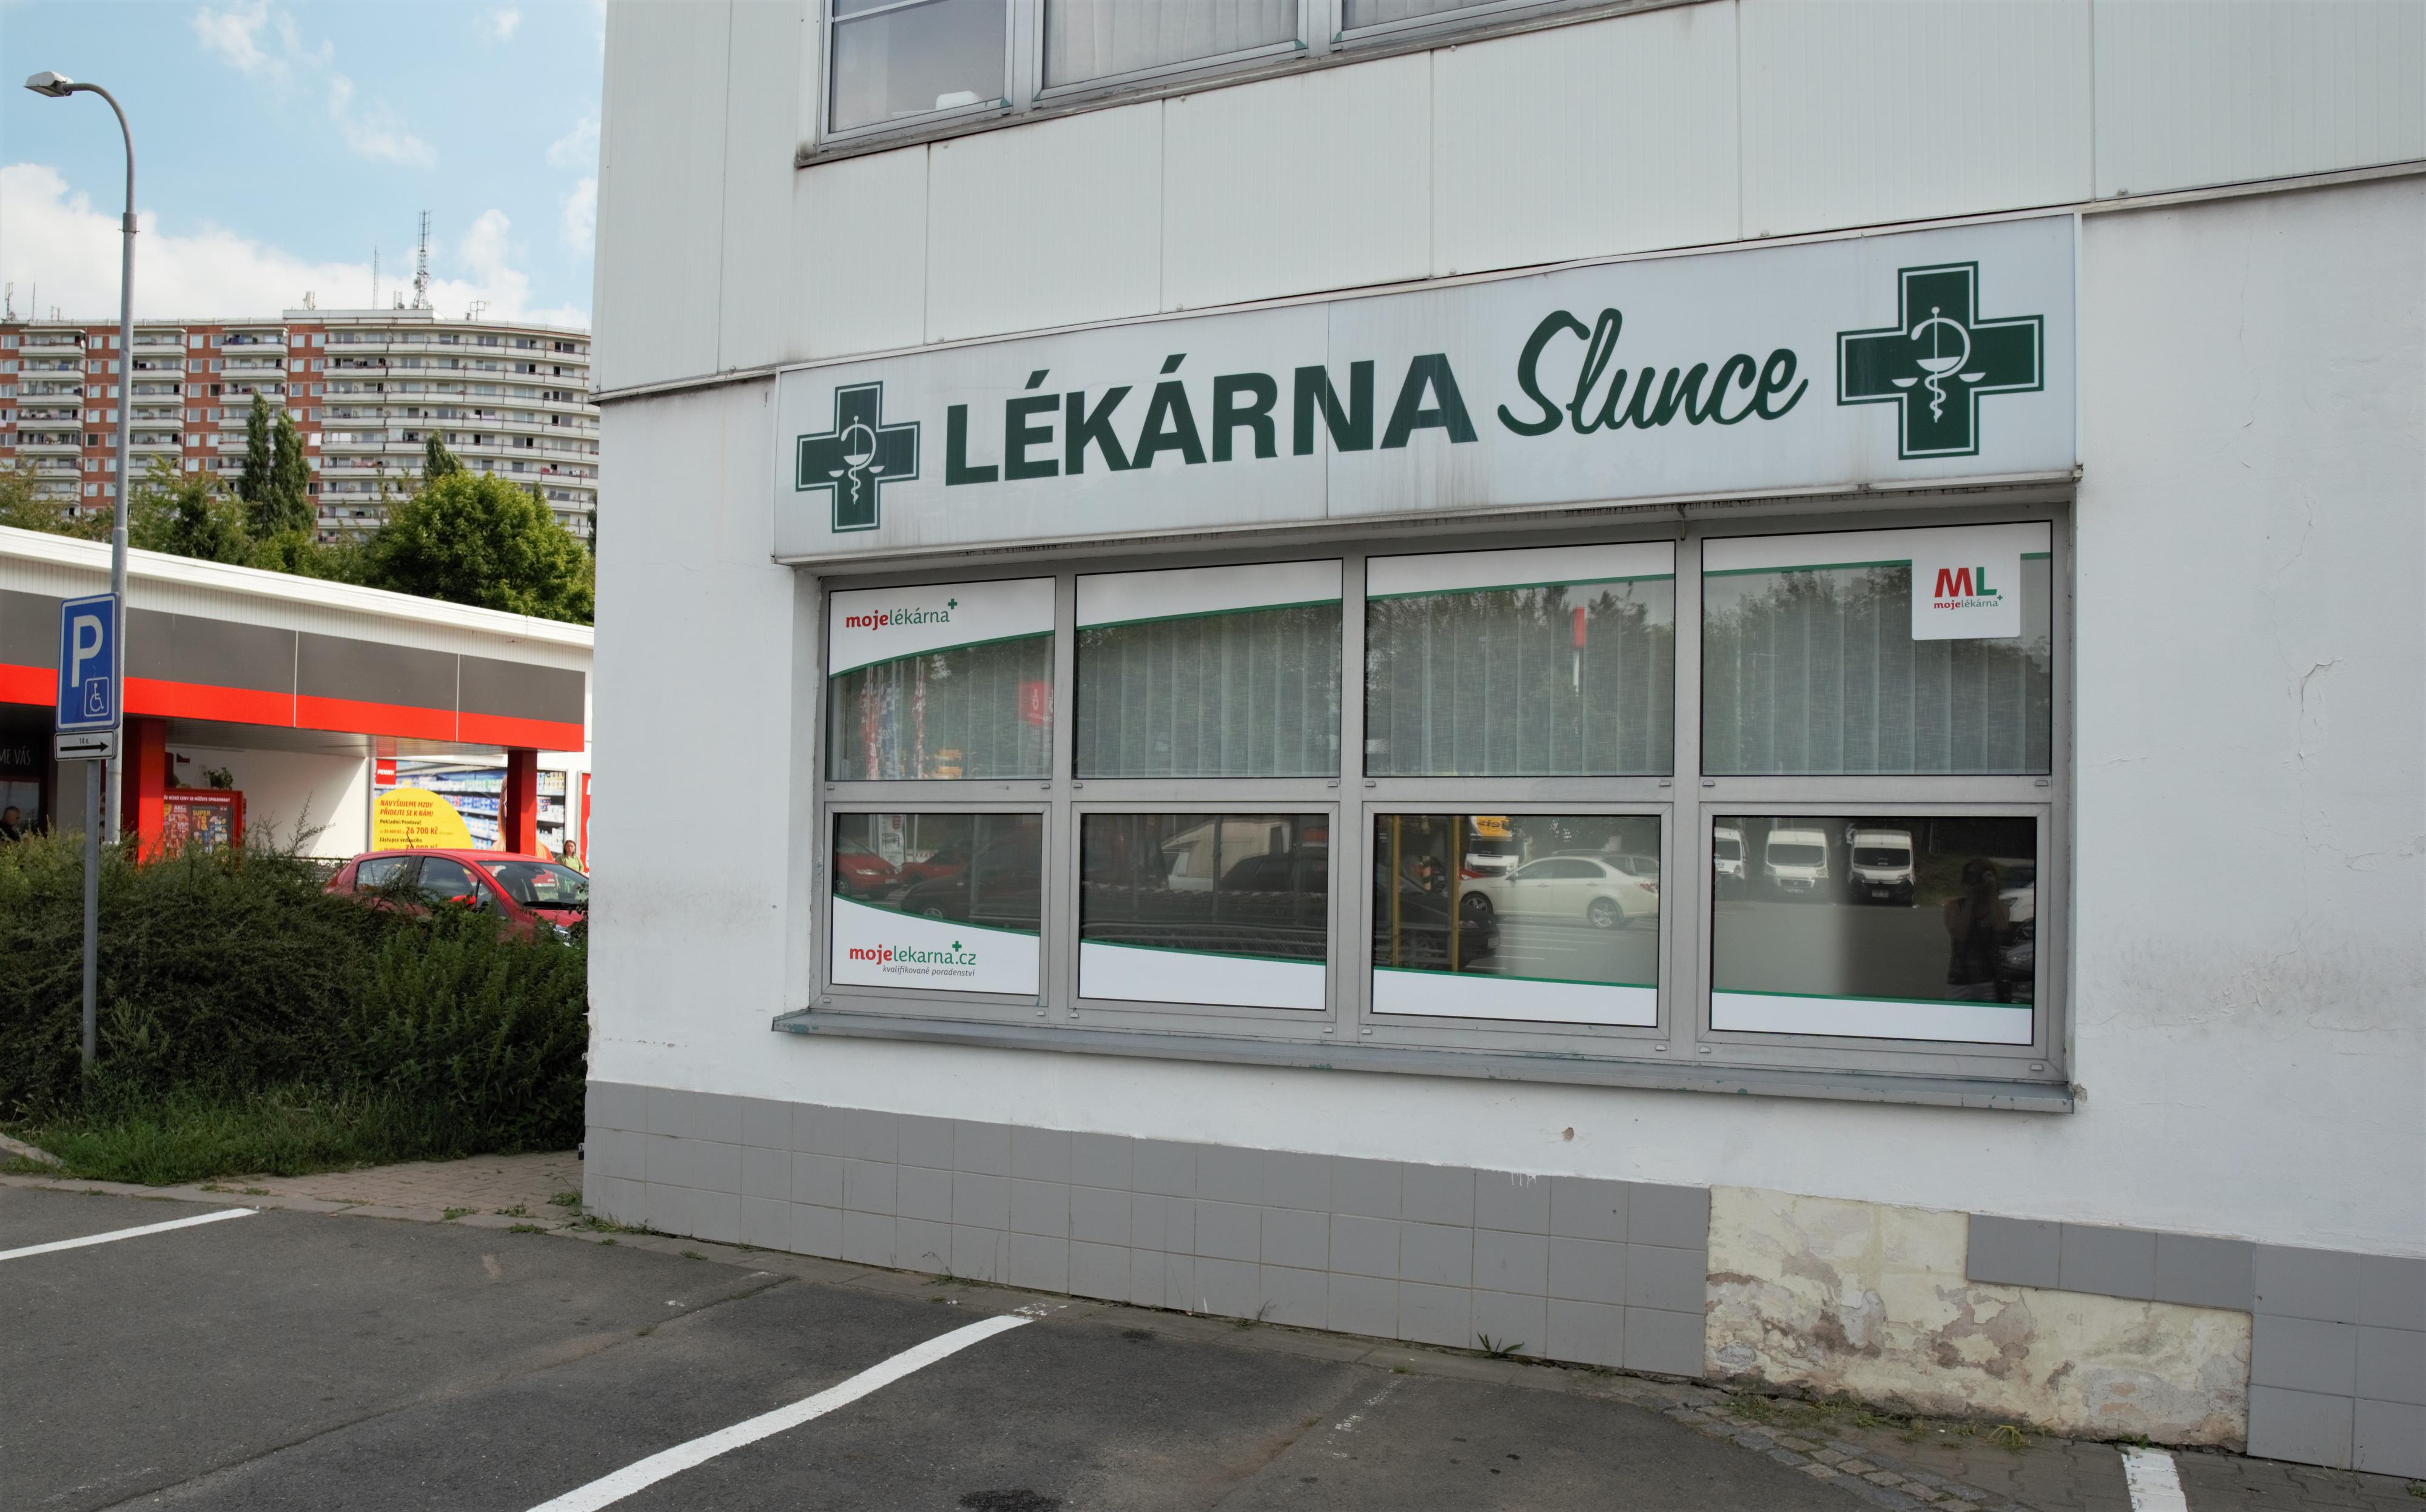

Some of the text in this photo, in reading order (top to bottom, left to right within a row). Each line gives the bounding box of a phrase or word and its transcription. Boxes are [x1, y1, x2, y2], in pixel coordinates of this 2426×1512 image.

[946, 308, 1809, 486] LÉKÁRNA Slunce
[1934, 566, 1997, 597] ML
[1934, 599, 1998, 610] mojelékárna
[846, 608, 950, 631] mojelékárna
[72, 614, 103, 687] P
[13, 745, 30, 765] VÁS
[418, 808, 433, 817] NÁM!
[430, 826, 438, 835] Kč
[850, 944, 976, 966] mojelekarna.cz
[882, 966, 975, 977] kvalifikované poradenství
